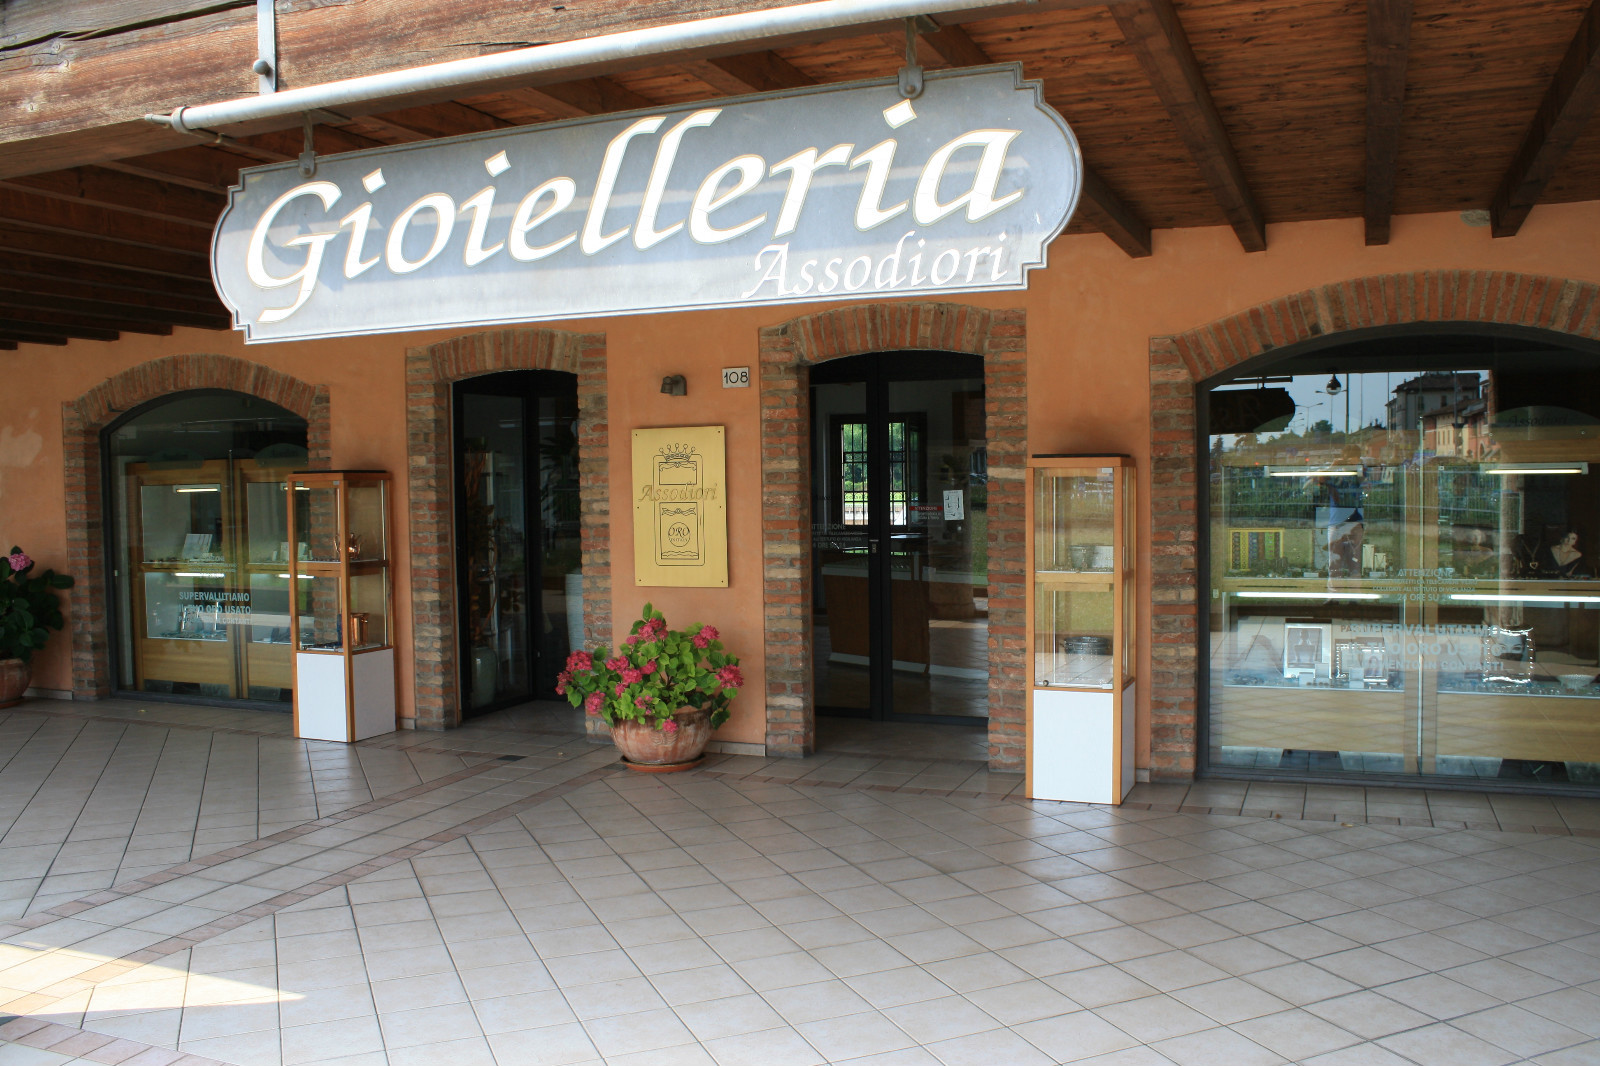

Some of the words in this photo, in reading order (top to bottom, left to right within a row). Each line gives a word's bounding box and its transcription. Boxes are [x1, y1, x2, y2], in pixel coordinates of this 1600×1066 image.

[246, 99, 1023, 323] Gioielleria
[741, 230, 1008, 299] Assodiori
[723, 371, 749, 385] 108
[638, 482, 718, 502] Assodiori
[668, 526, 690, 539] ORO
[1397, 568, 1453, 577] ATTENZIONE
[179, 592, 250, 601] SUPERVALUTIAMO
[1409, 593, 1426, 601] ORE
[1428, 594, 1440, 602] SU
[224, 605, 251, 615] USATO
[1350, 623, 1500, 636] SUPERVALUTIAMO
[1407, 643, 1442, 656] ORO
